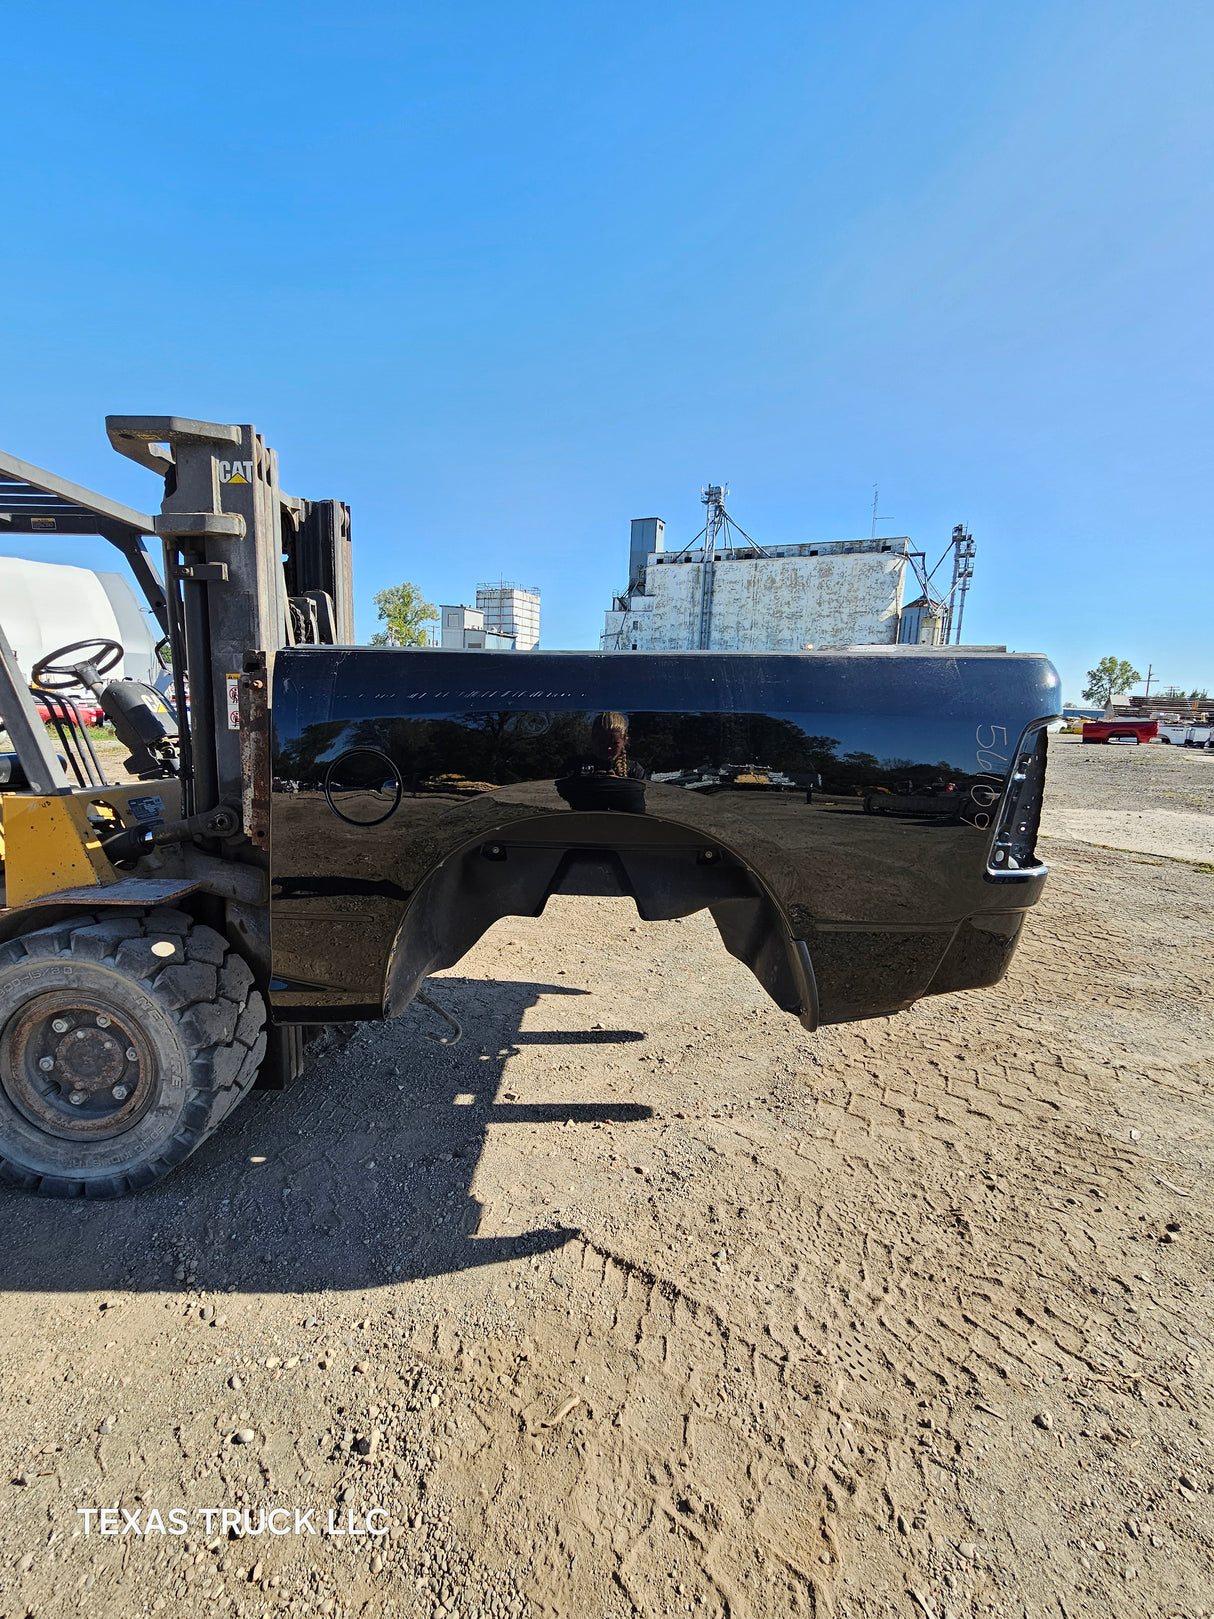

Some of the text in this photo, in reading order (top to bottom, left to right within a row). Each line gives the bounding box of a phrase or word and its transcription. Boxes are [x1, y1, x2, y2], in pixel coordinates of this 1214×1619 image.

[219, 461, 253, 483] CAT
[141, 694, 163, 713] CA
[959, 724, 1007, 830] 56109
